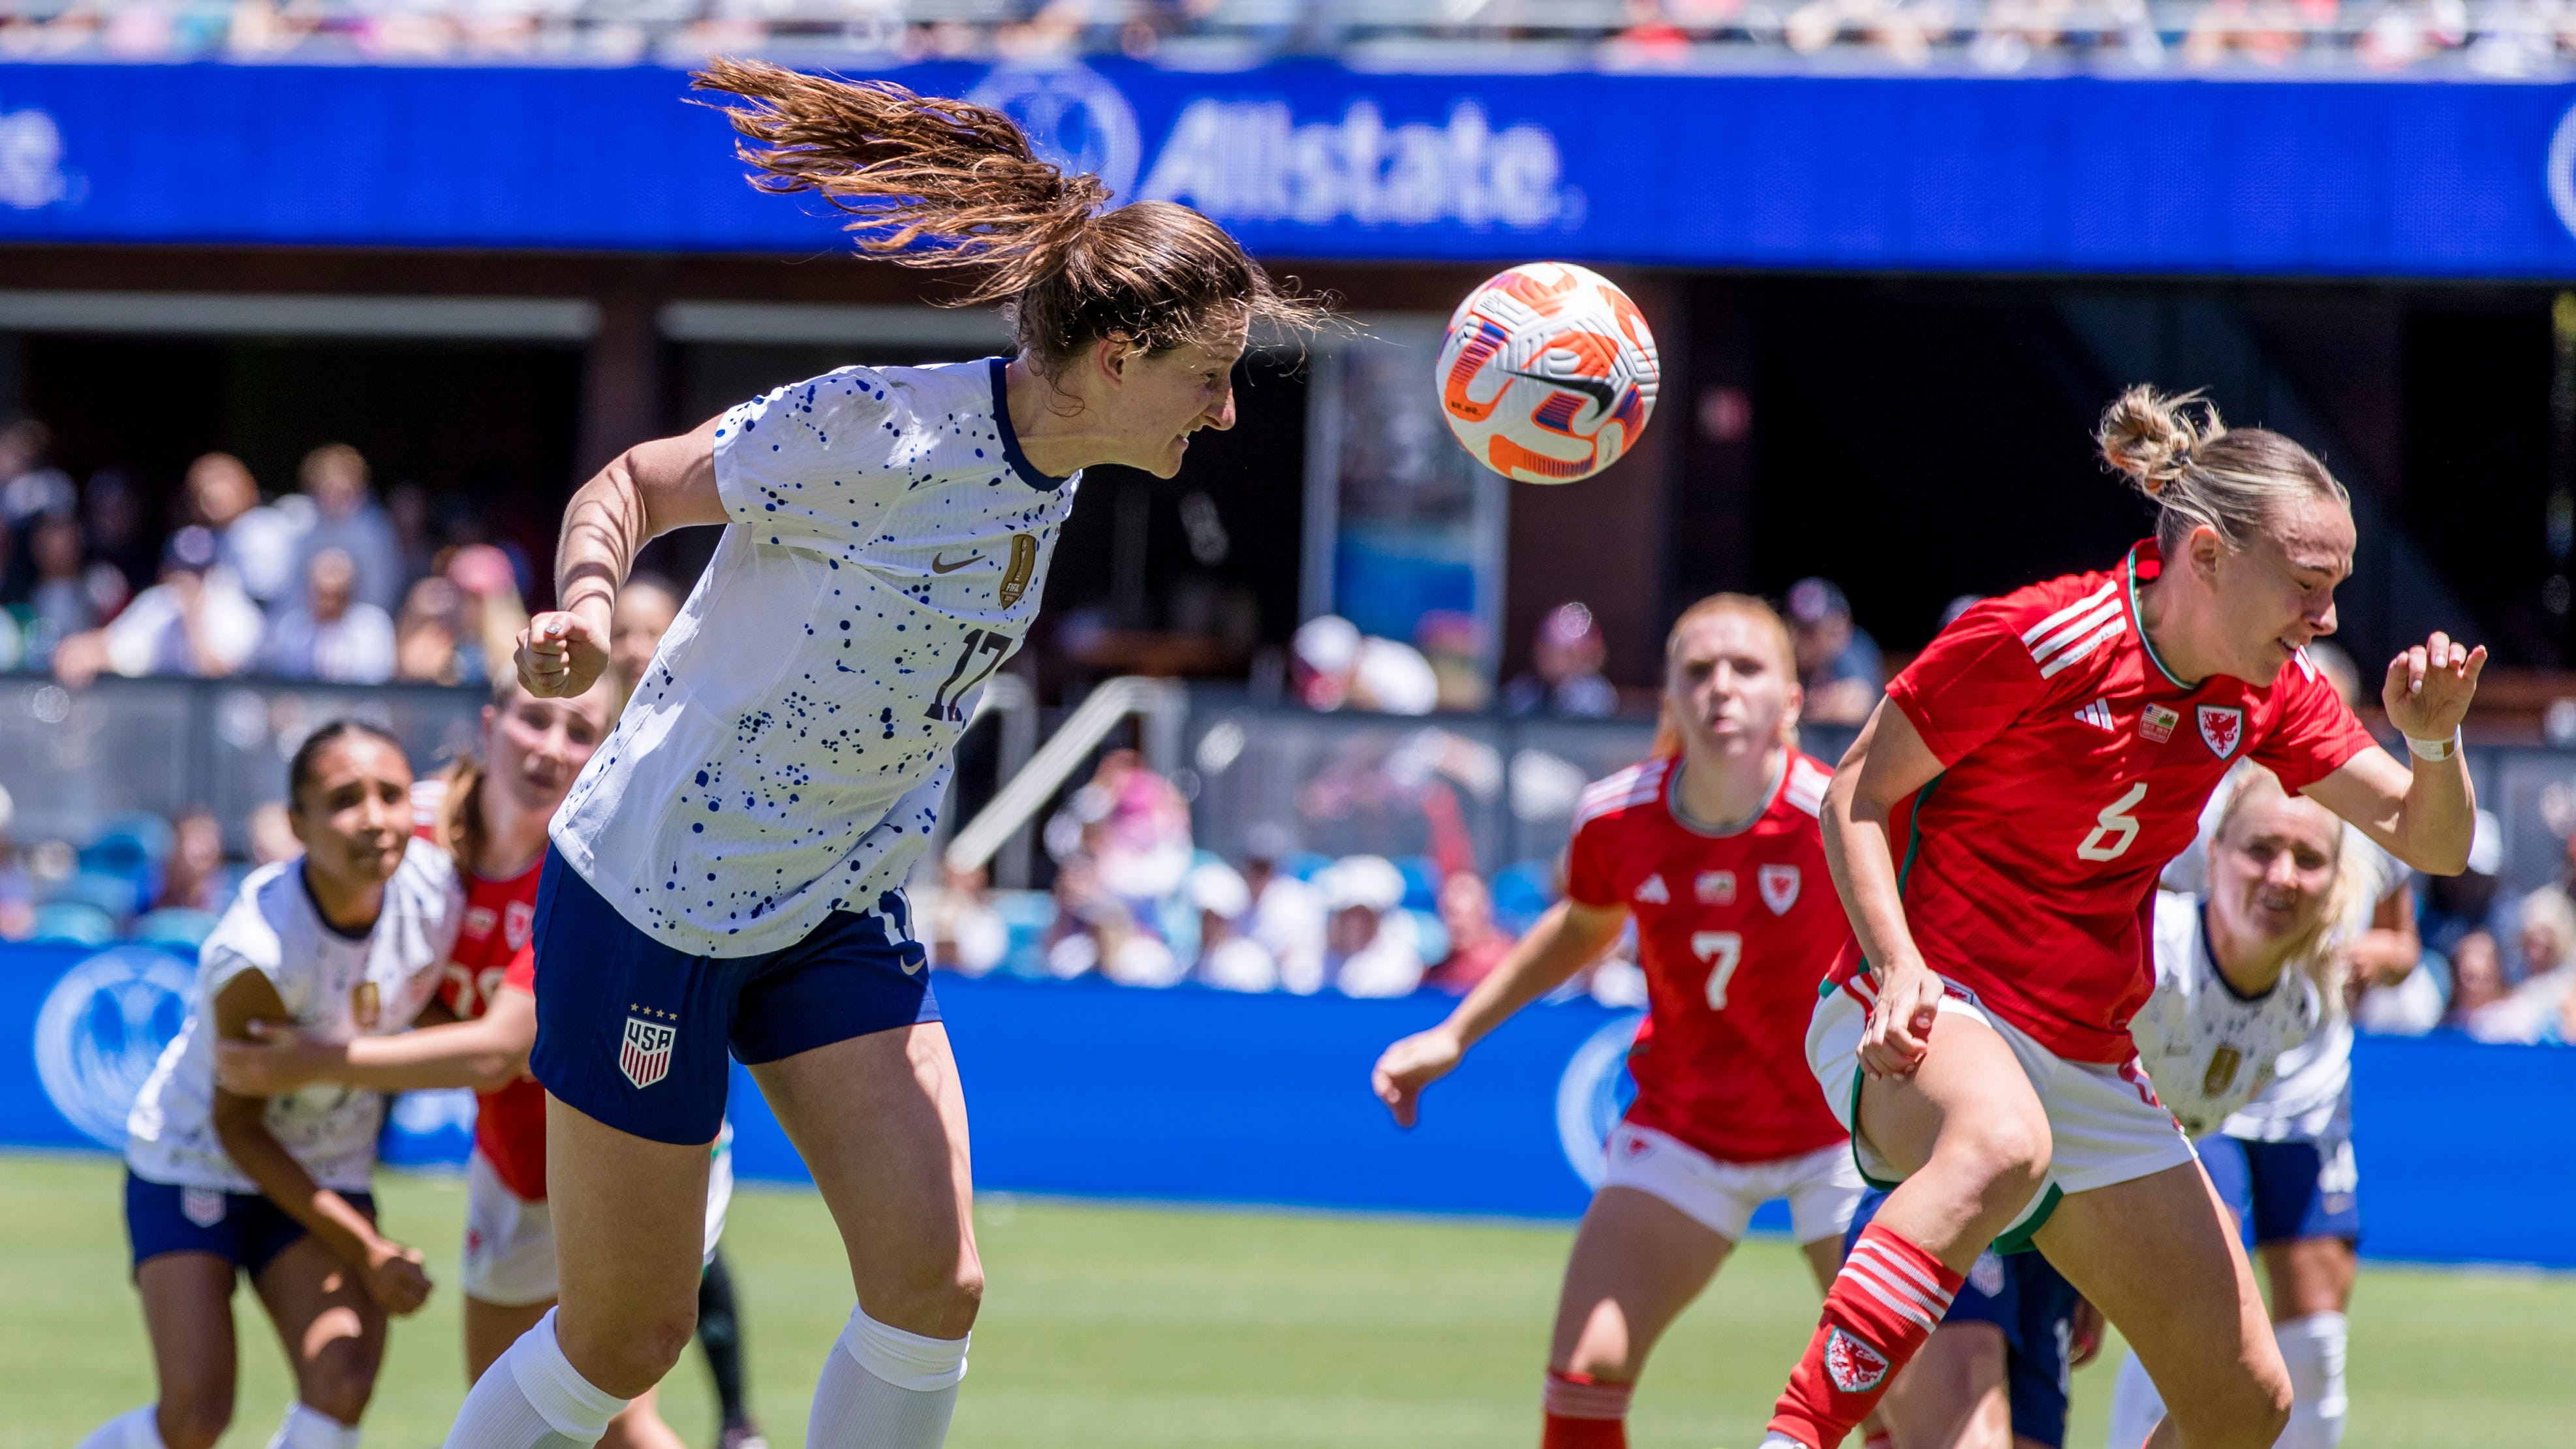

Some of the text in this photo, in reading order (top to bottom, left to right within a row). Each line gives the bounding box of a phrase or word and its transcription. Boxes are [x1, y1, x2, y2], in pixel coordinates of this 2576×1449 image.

[1141, 97, 1568, 227] Allstate
[1006, 582, 1019, 592] FIFA
[923, 628, 1014, 722] 17
[2077, 782, 2148, 862] 6
[1690, 930, 1743, 1012] 7
[627, 1021, 672, 1052] USA
